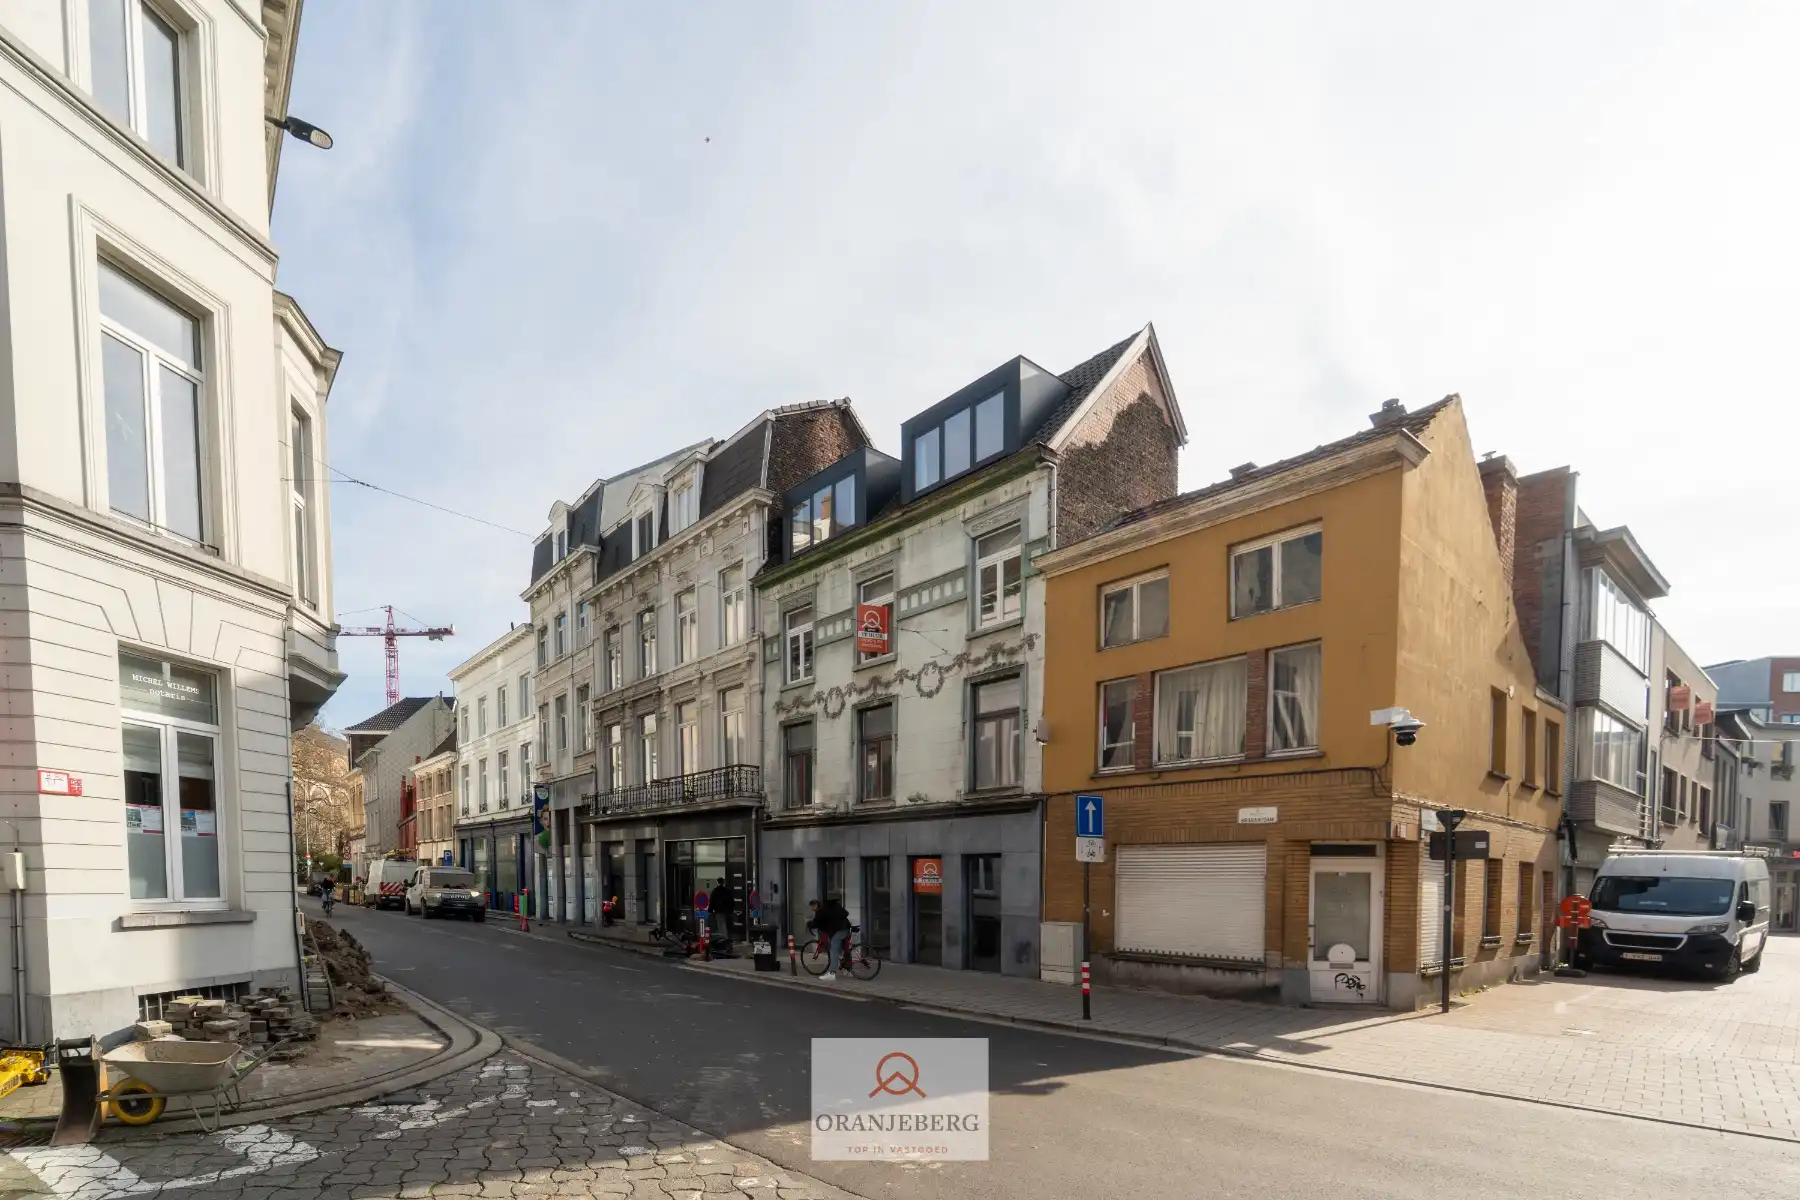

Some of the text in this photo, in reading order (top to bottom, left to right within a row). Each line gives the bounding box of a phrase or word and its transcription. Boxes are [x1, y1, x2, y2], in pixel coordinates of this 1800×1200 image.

[132, 674, 200, 694] MICHEL WILLEMS
[149, 688, 186, 701] notaris
